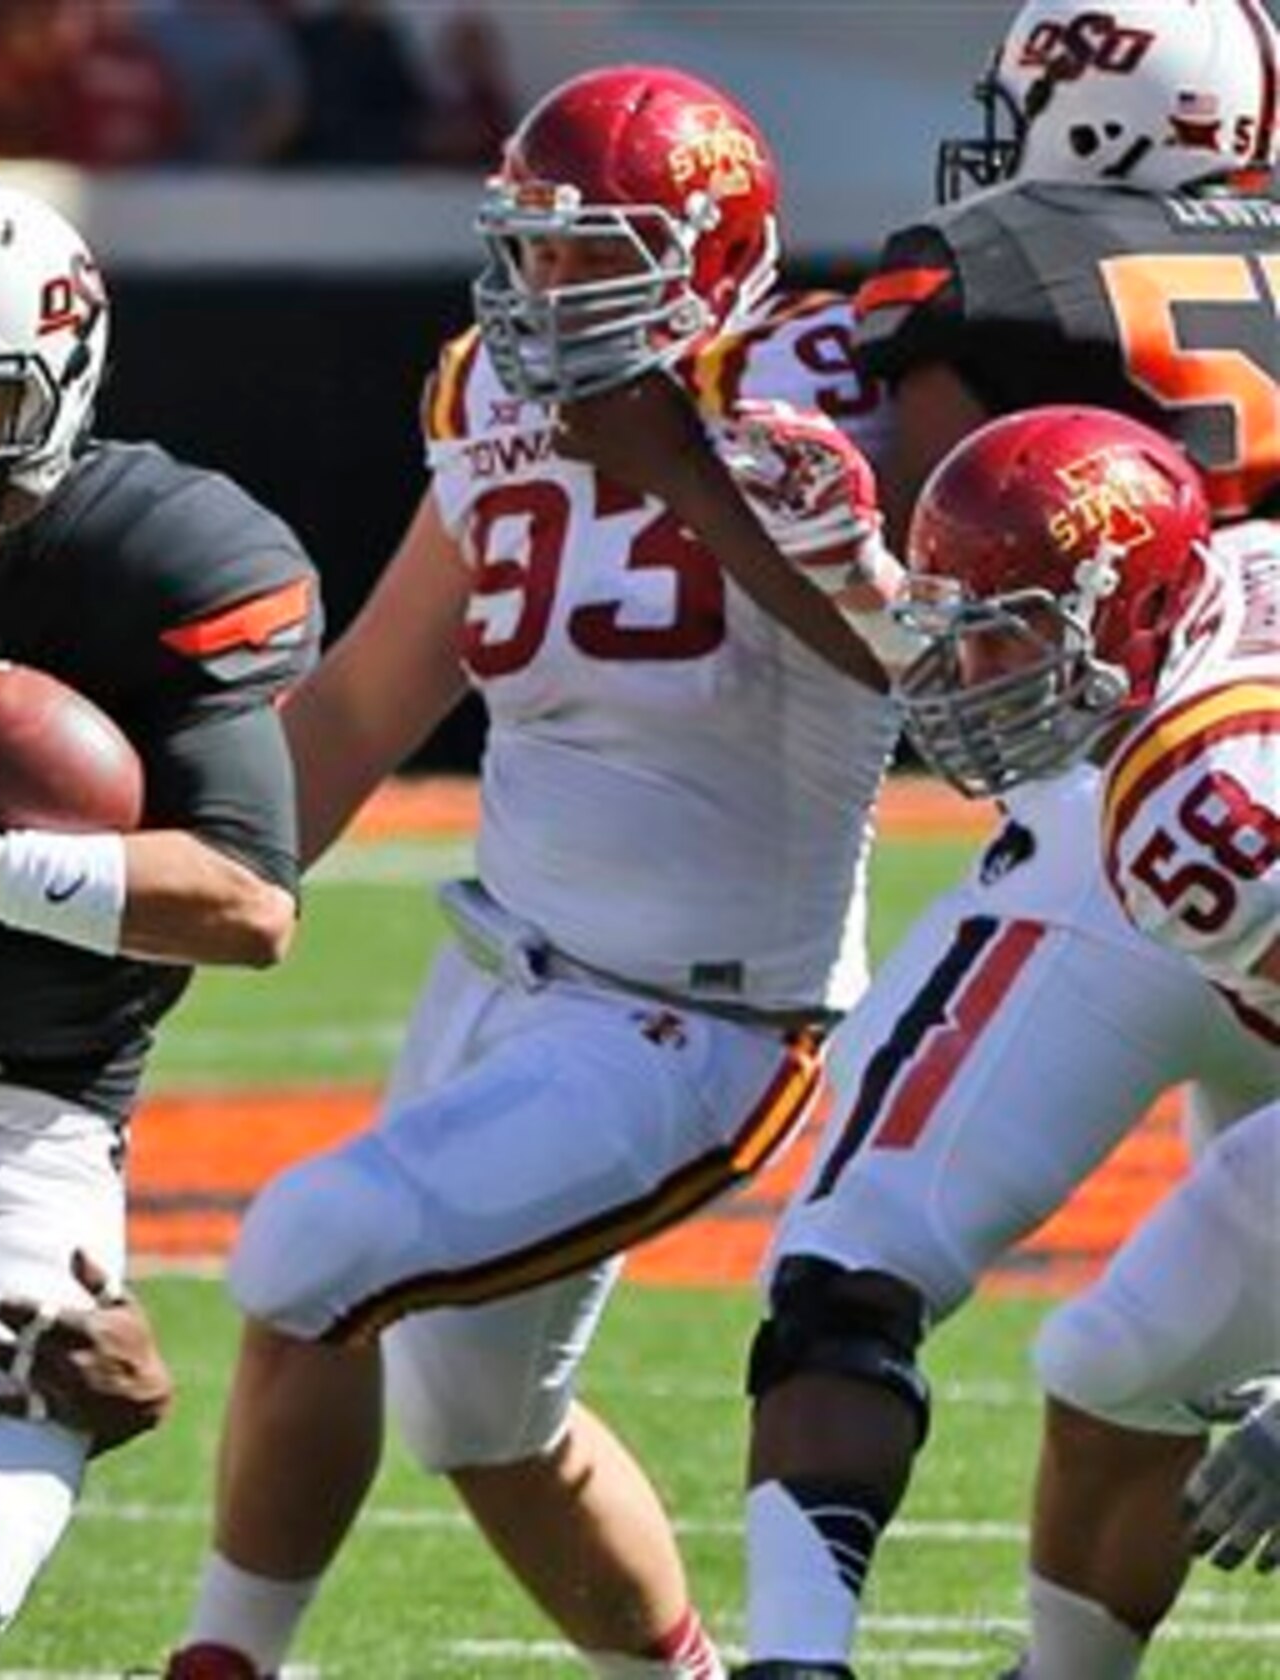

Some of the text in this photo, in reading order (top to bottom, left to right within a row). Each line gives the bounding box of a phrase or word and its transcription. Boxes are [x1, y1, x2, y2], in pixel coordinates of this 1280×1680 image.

[1097, 252, 1280, 518] 5
[455, 479, 725, 670] 93
[1130, 769, 1280, 936] 58
